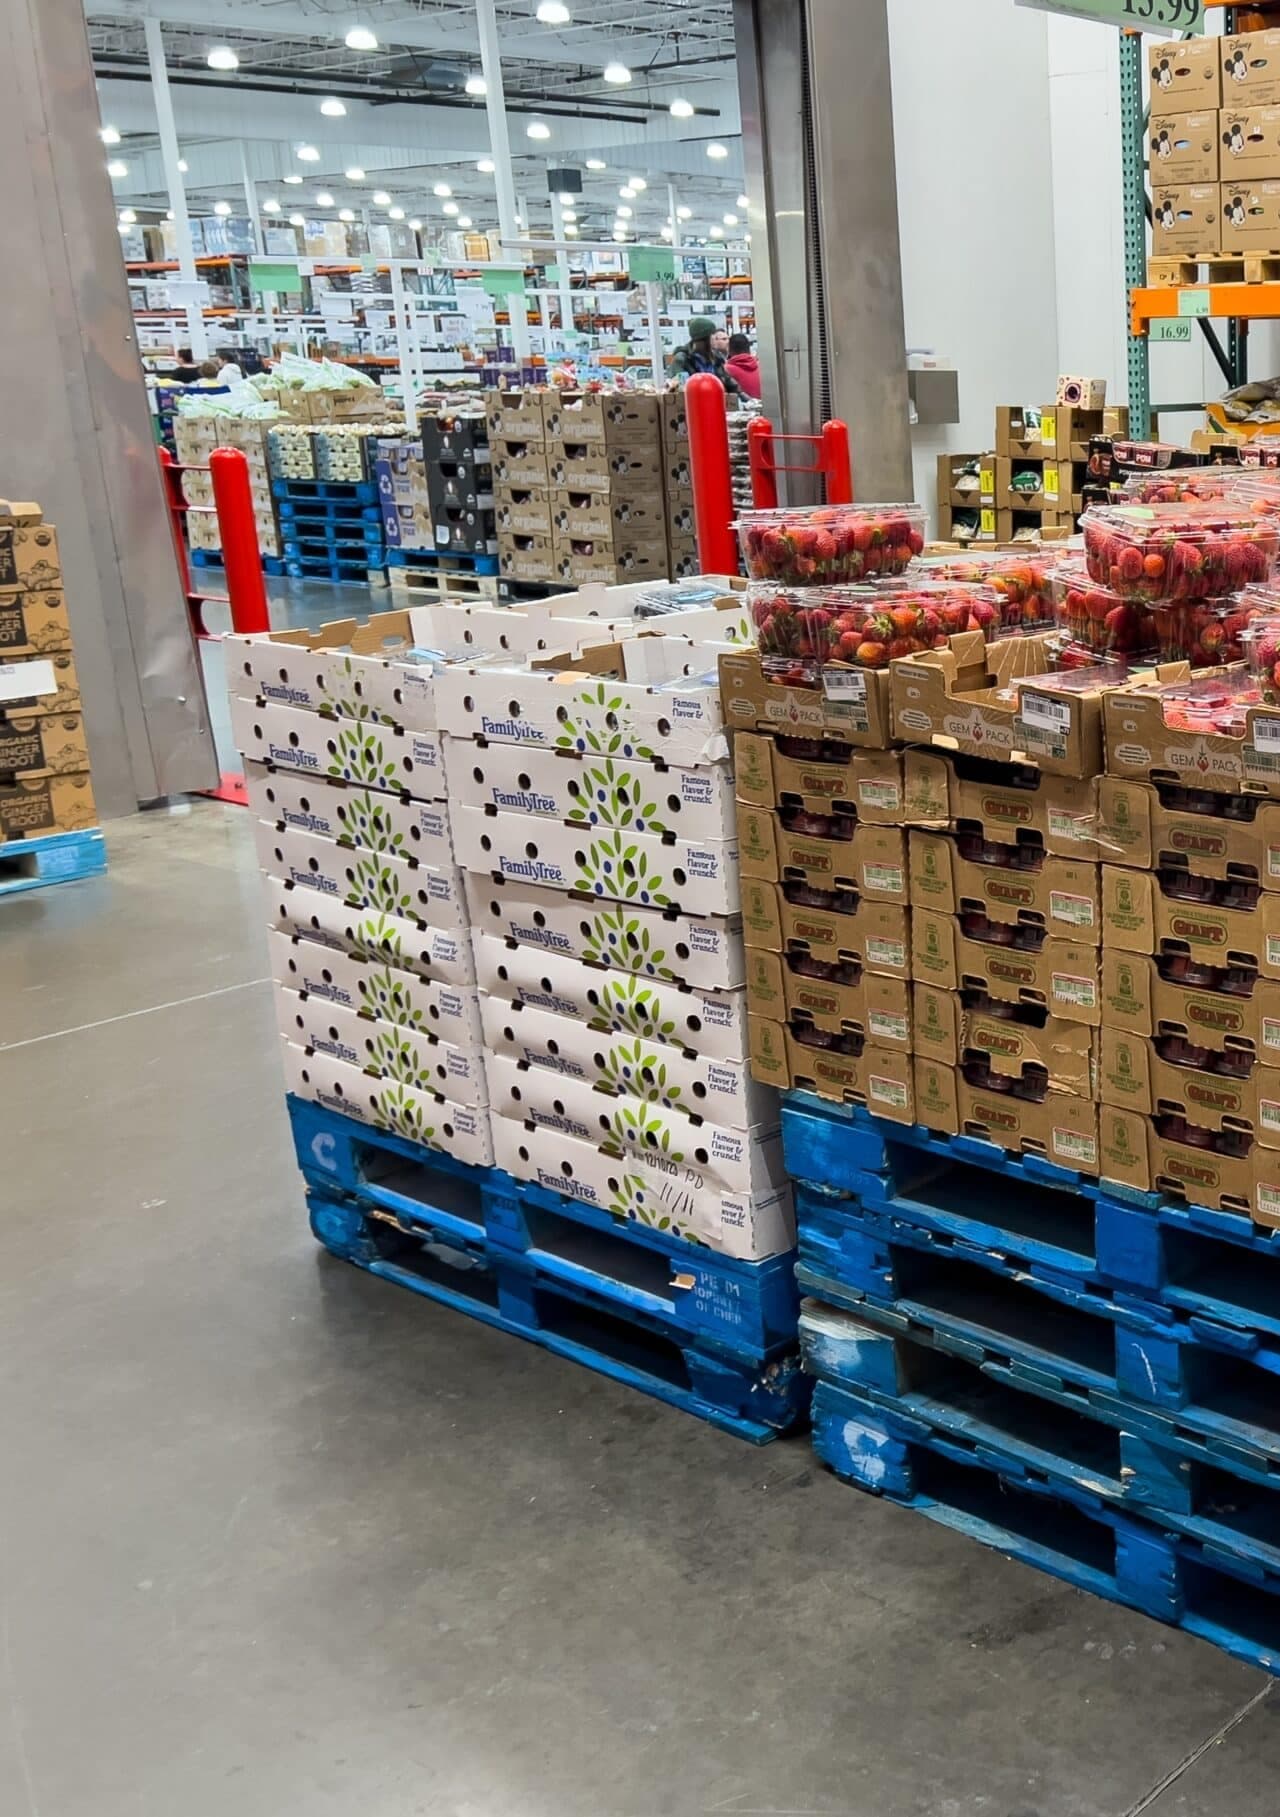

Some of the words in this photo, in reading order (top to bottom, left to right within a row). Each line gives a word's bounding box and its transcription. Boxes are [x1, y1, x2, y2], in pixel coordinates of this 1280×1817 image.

[656, 272, 674, 281] 3.99
[1160, 327, 1189, 339] 16.99
[672, 698, 701, 709] Famous
[672, 708, 694, 718] flavor
[950, 722, 970, 736] GEM
[986, 729, 1010, 744] PACK
[0, 744, 39, 757] INGER
[1171, 753, 1195, 767] GEM
[1212, 758, 1237, 772] PACK
[681, 775, 711, 786] Famous
[681, 785, 703, 795] flavor
[492, 788, 556, 812] FamilyTree
[1, 803, 49, 819] GINGER
[9, 813, 46, 828] ROOT
[687, 849, 716, 861] Famous
[500, 856, 562, 881] FamilyTree
[687, 859, 708, 870] flavor
[689, 924, 717, 936] Famous
[1173, 919, 1223, 942] GIANT
[689, 934, 710, 945] flavor
[703, 997, 731, 1010] Famous
[703, 1007, 724, 1018] flavor
[1188, 1006, 1240, 1029] GIANT
[708, 1065, 736, 1079] Famous
[708, 1074, 729, 1085] flavor
[1187, 1084, 1238, 1110] GIANT
[712, 1131, 741, 1146] Famous
[712, 1140, 733, 1153] flavor
[1167, 1160, 1216, 1185] GIANT
